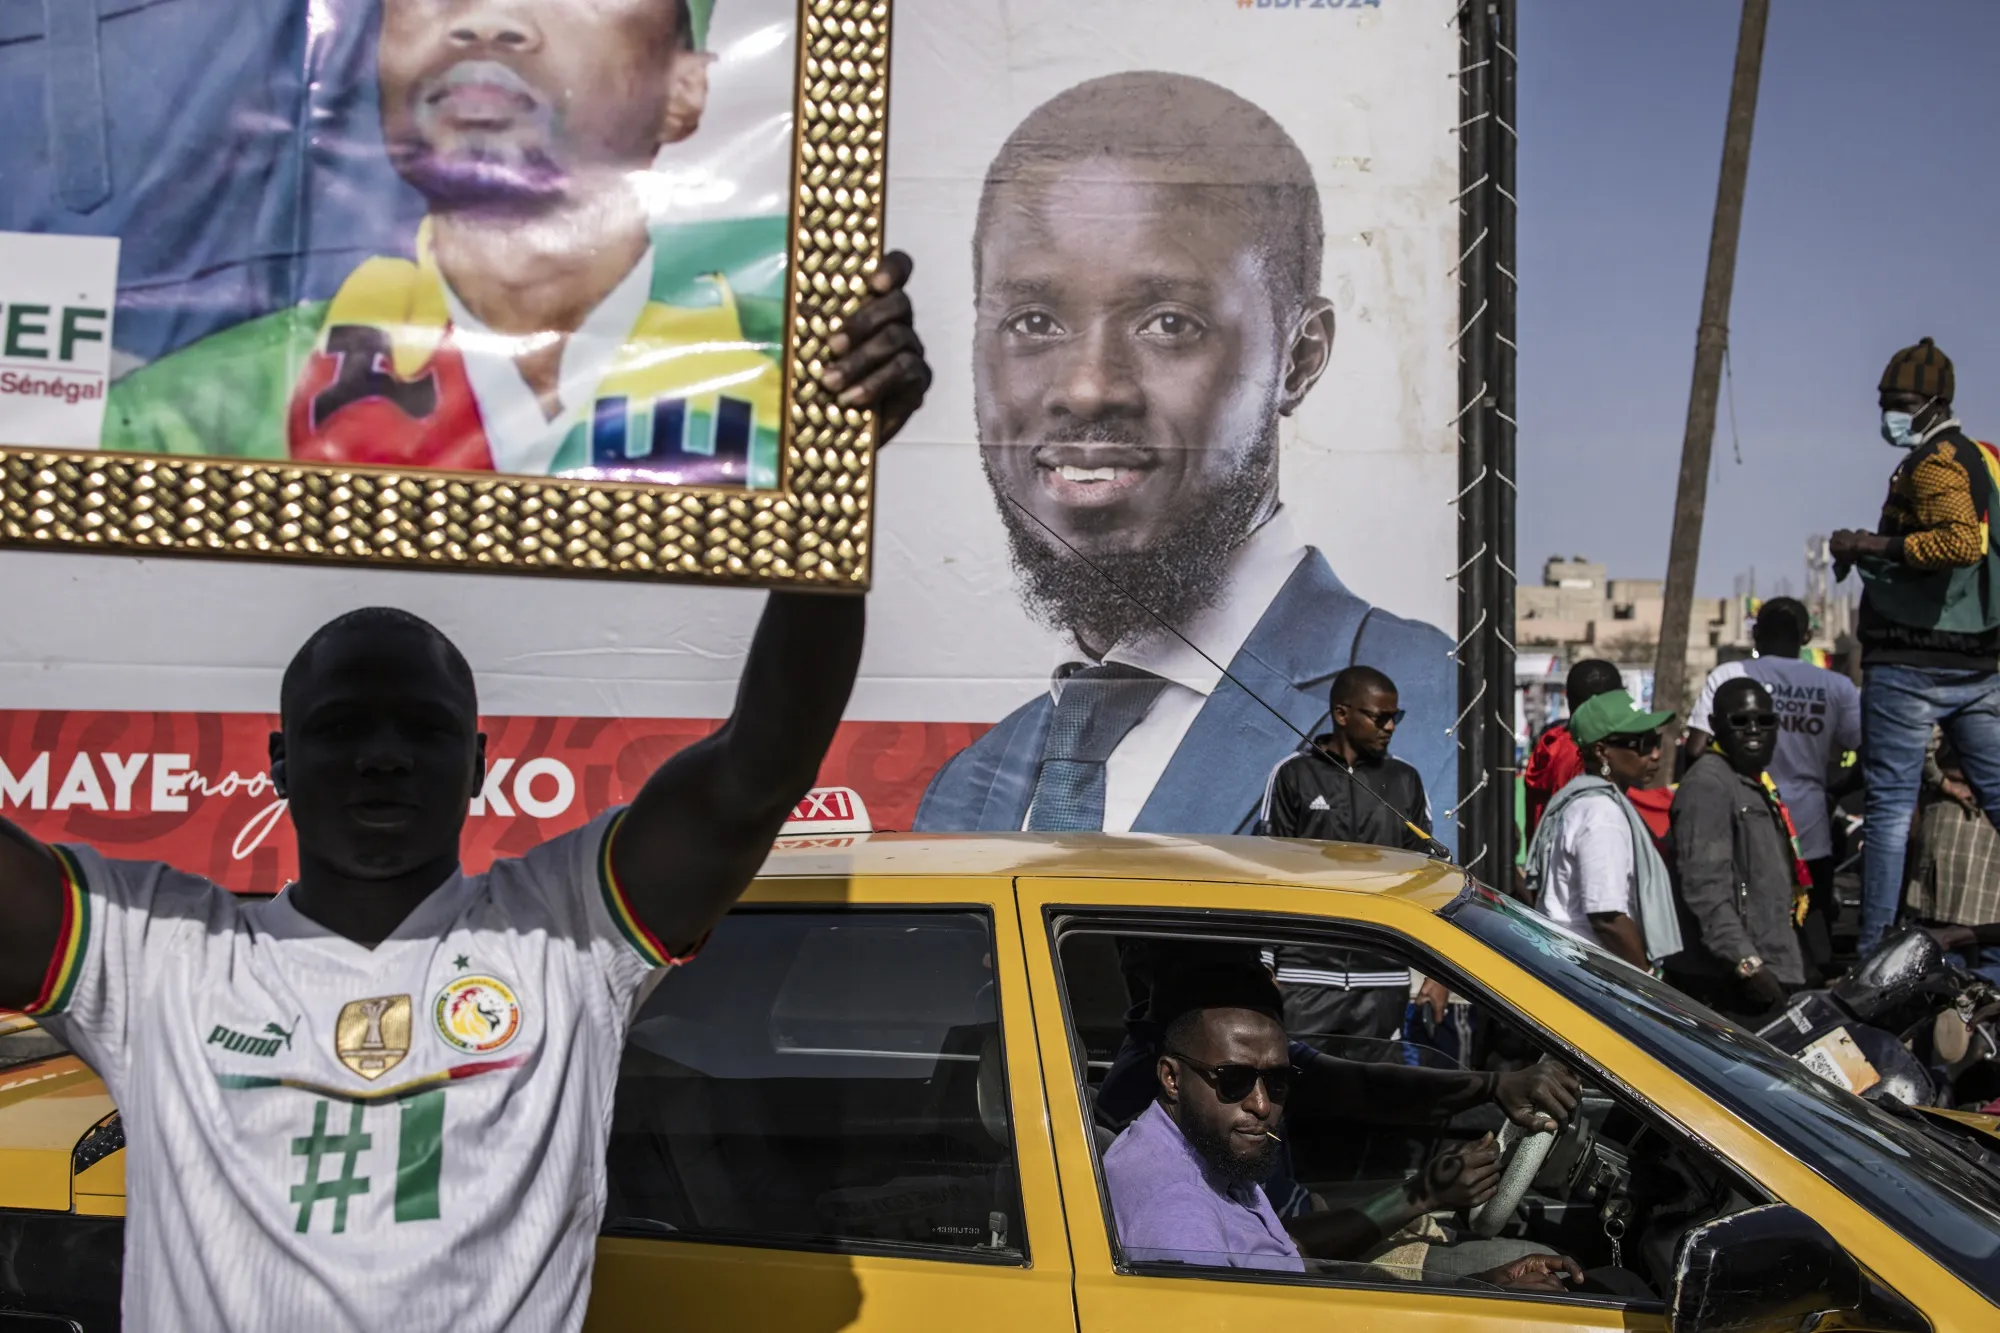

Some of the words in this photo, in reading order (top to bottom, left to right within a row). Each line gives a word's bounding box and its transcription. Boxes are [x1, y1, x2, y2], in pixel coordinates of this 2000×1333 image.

[0, 303, 107, 361] EF
[0, 371, 103, 404] Sénégal
[0, 751, 190, 812] MAYE
[469, 757, 576, 819] KO
[206, 1024, 283, 1057] PUMA
[290, 1090, 446, 1234] #1
